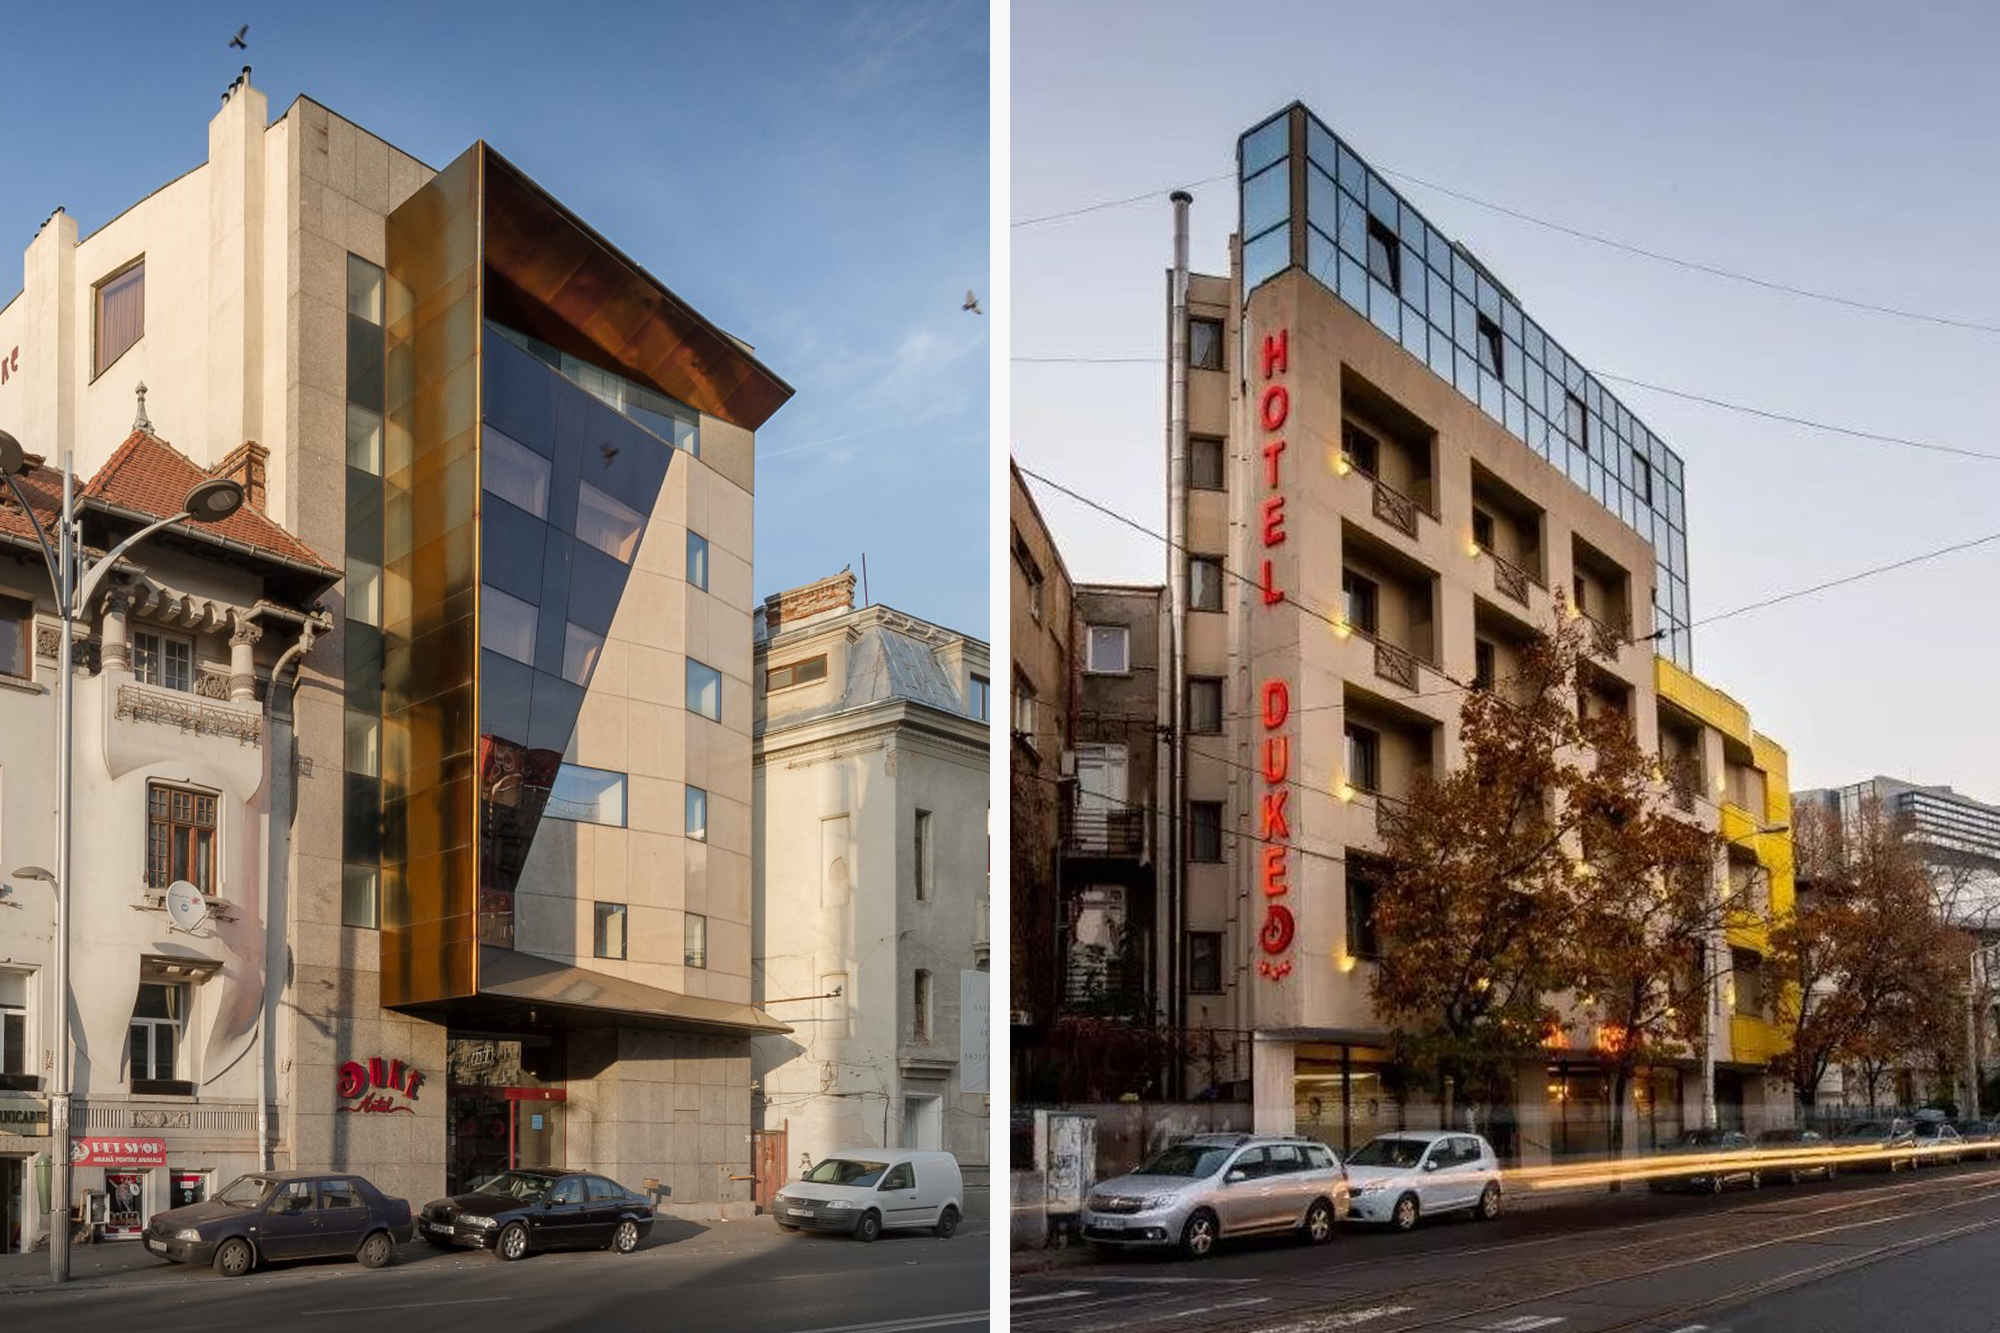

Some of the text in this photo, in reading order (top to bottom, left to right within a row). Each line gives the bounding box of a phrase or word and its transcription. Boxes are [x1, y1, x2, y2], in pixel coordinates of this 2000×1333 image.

[1260, 329, 1289, 898] HOTEL DUKE
[92, 1142, 163, 1155] PET SHOP
